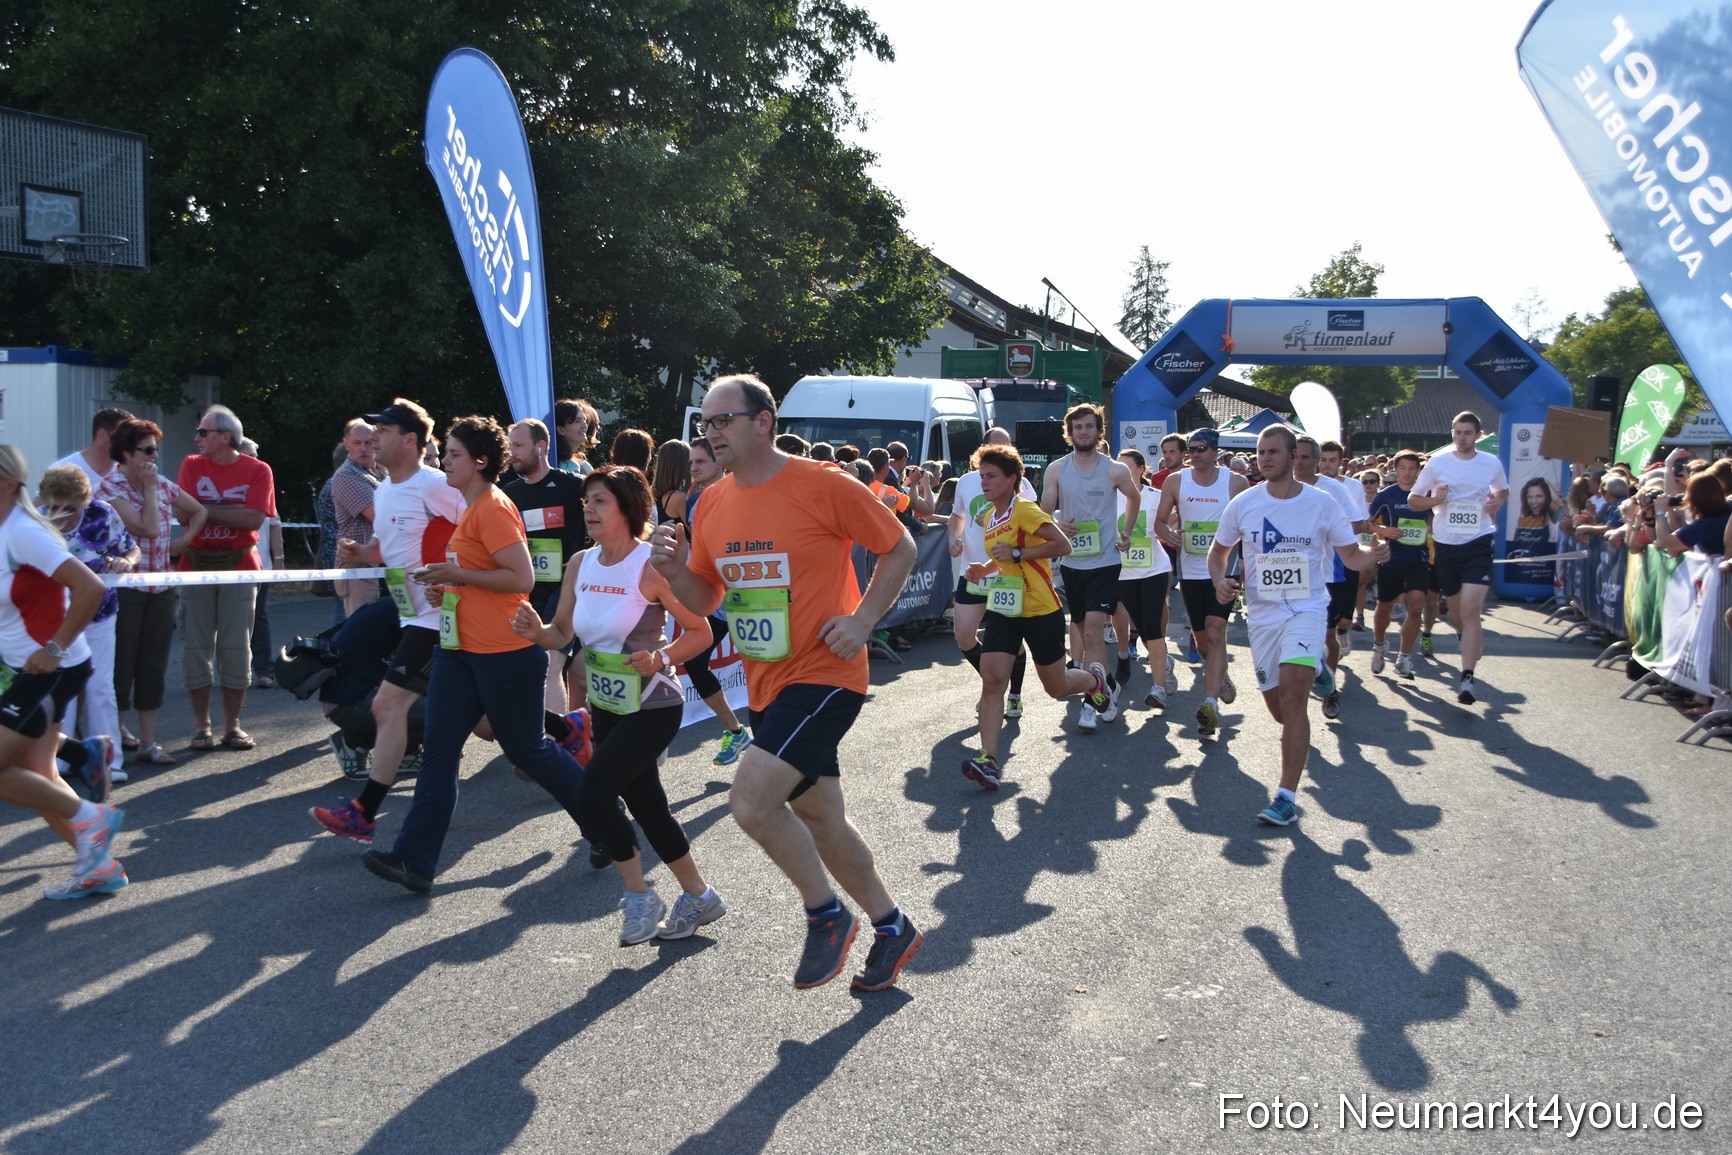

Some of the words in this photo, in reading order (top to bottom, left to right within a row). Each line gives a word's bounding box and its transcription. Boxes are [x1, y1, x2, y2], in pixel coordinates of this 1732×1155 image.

[1313, 331, 1395, 346] firmenlauf
[1162, 359, 1205, 368] Fischer
[1649, 401, 1673, 428] AOK
[1620, 420, 1649, 451] AOK
[1449, 512, 1477, 525] 8933
[985, 532, 997, 541] MAX
[997, 525, 1014, 537] BÖGL
[1192, 535, 1214, 546] 587
[1403, 529, 1421, 539] 382
[725, 542, 740, 553] 30
[744, 540, 773, 552] Jahre
[1071, 535, 1092, 548] 351
[1125, 549, 1145, 560] 128
[722, 561, 782, 582] OBI
[1262, 568, 1302, 586] 8921
[589, 584, 628, 595] KLEBL
[993, 591, 1016, 606] 893
[736, 618, 773, 642] 620
[591, 672, 626, 699] 582
